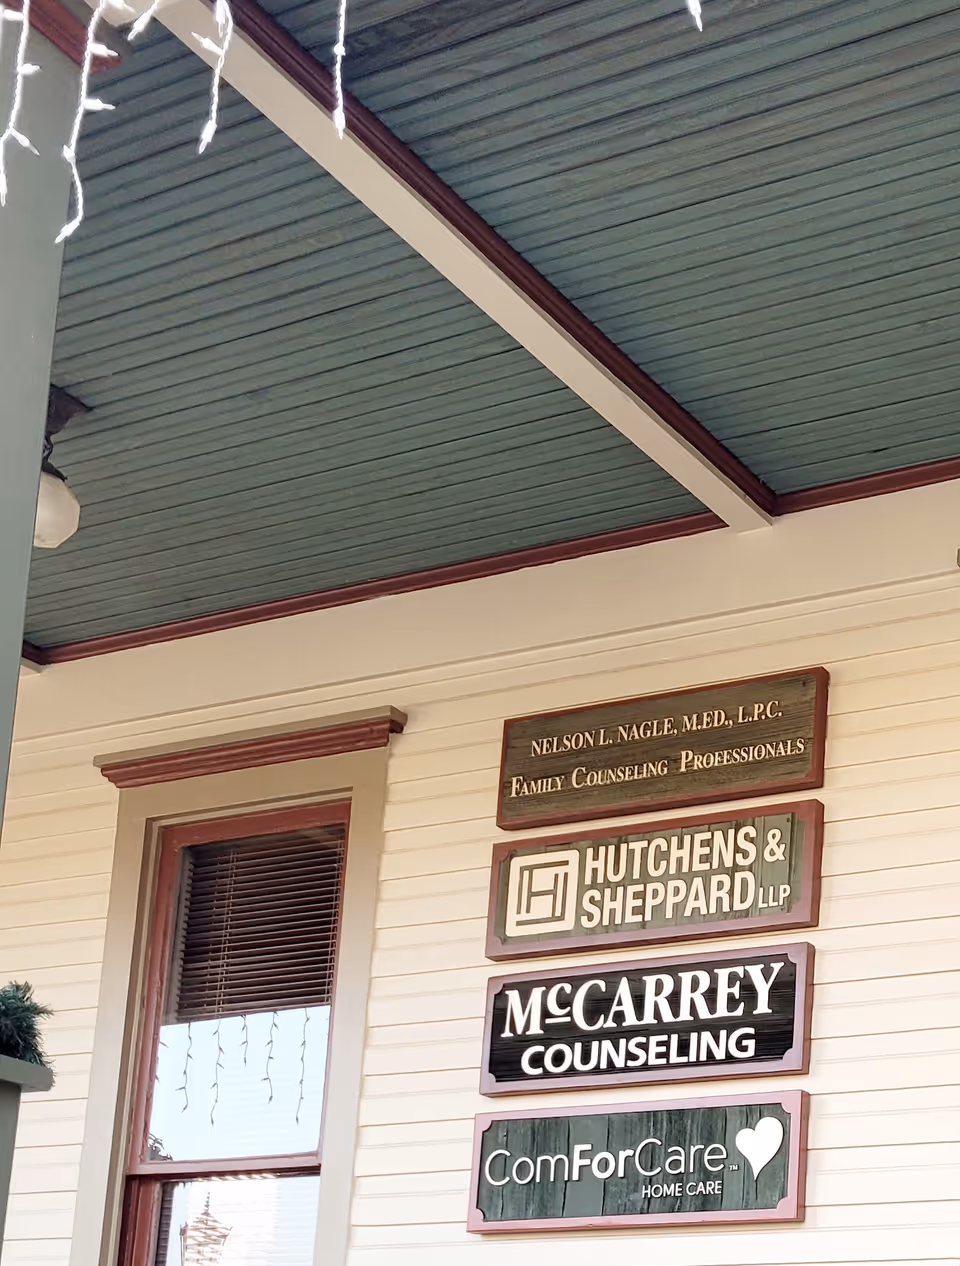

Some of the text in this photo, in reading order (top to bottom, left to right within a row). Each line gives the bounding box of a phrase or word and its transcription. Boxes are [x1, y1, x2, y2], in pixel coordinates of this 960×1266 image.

[530, 700, 783, 757] NELSON L. NAGLE, M.ED., L.P.C.
[584, 825, 786, 885] HUTCHENS &
[580, 870, 791, 929] SHEPPARD LLP
[500, 961, 785, 1037] McCARREY
[520, 1027, 756, 1076] COUNSELING
[484, 1137, 728, 1187] ComForCare
[641, 1180, 723, 1199] HOME CARE
